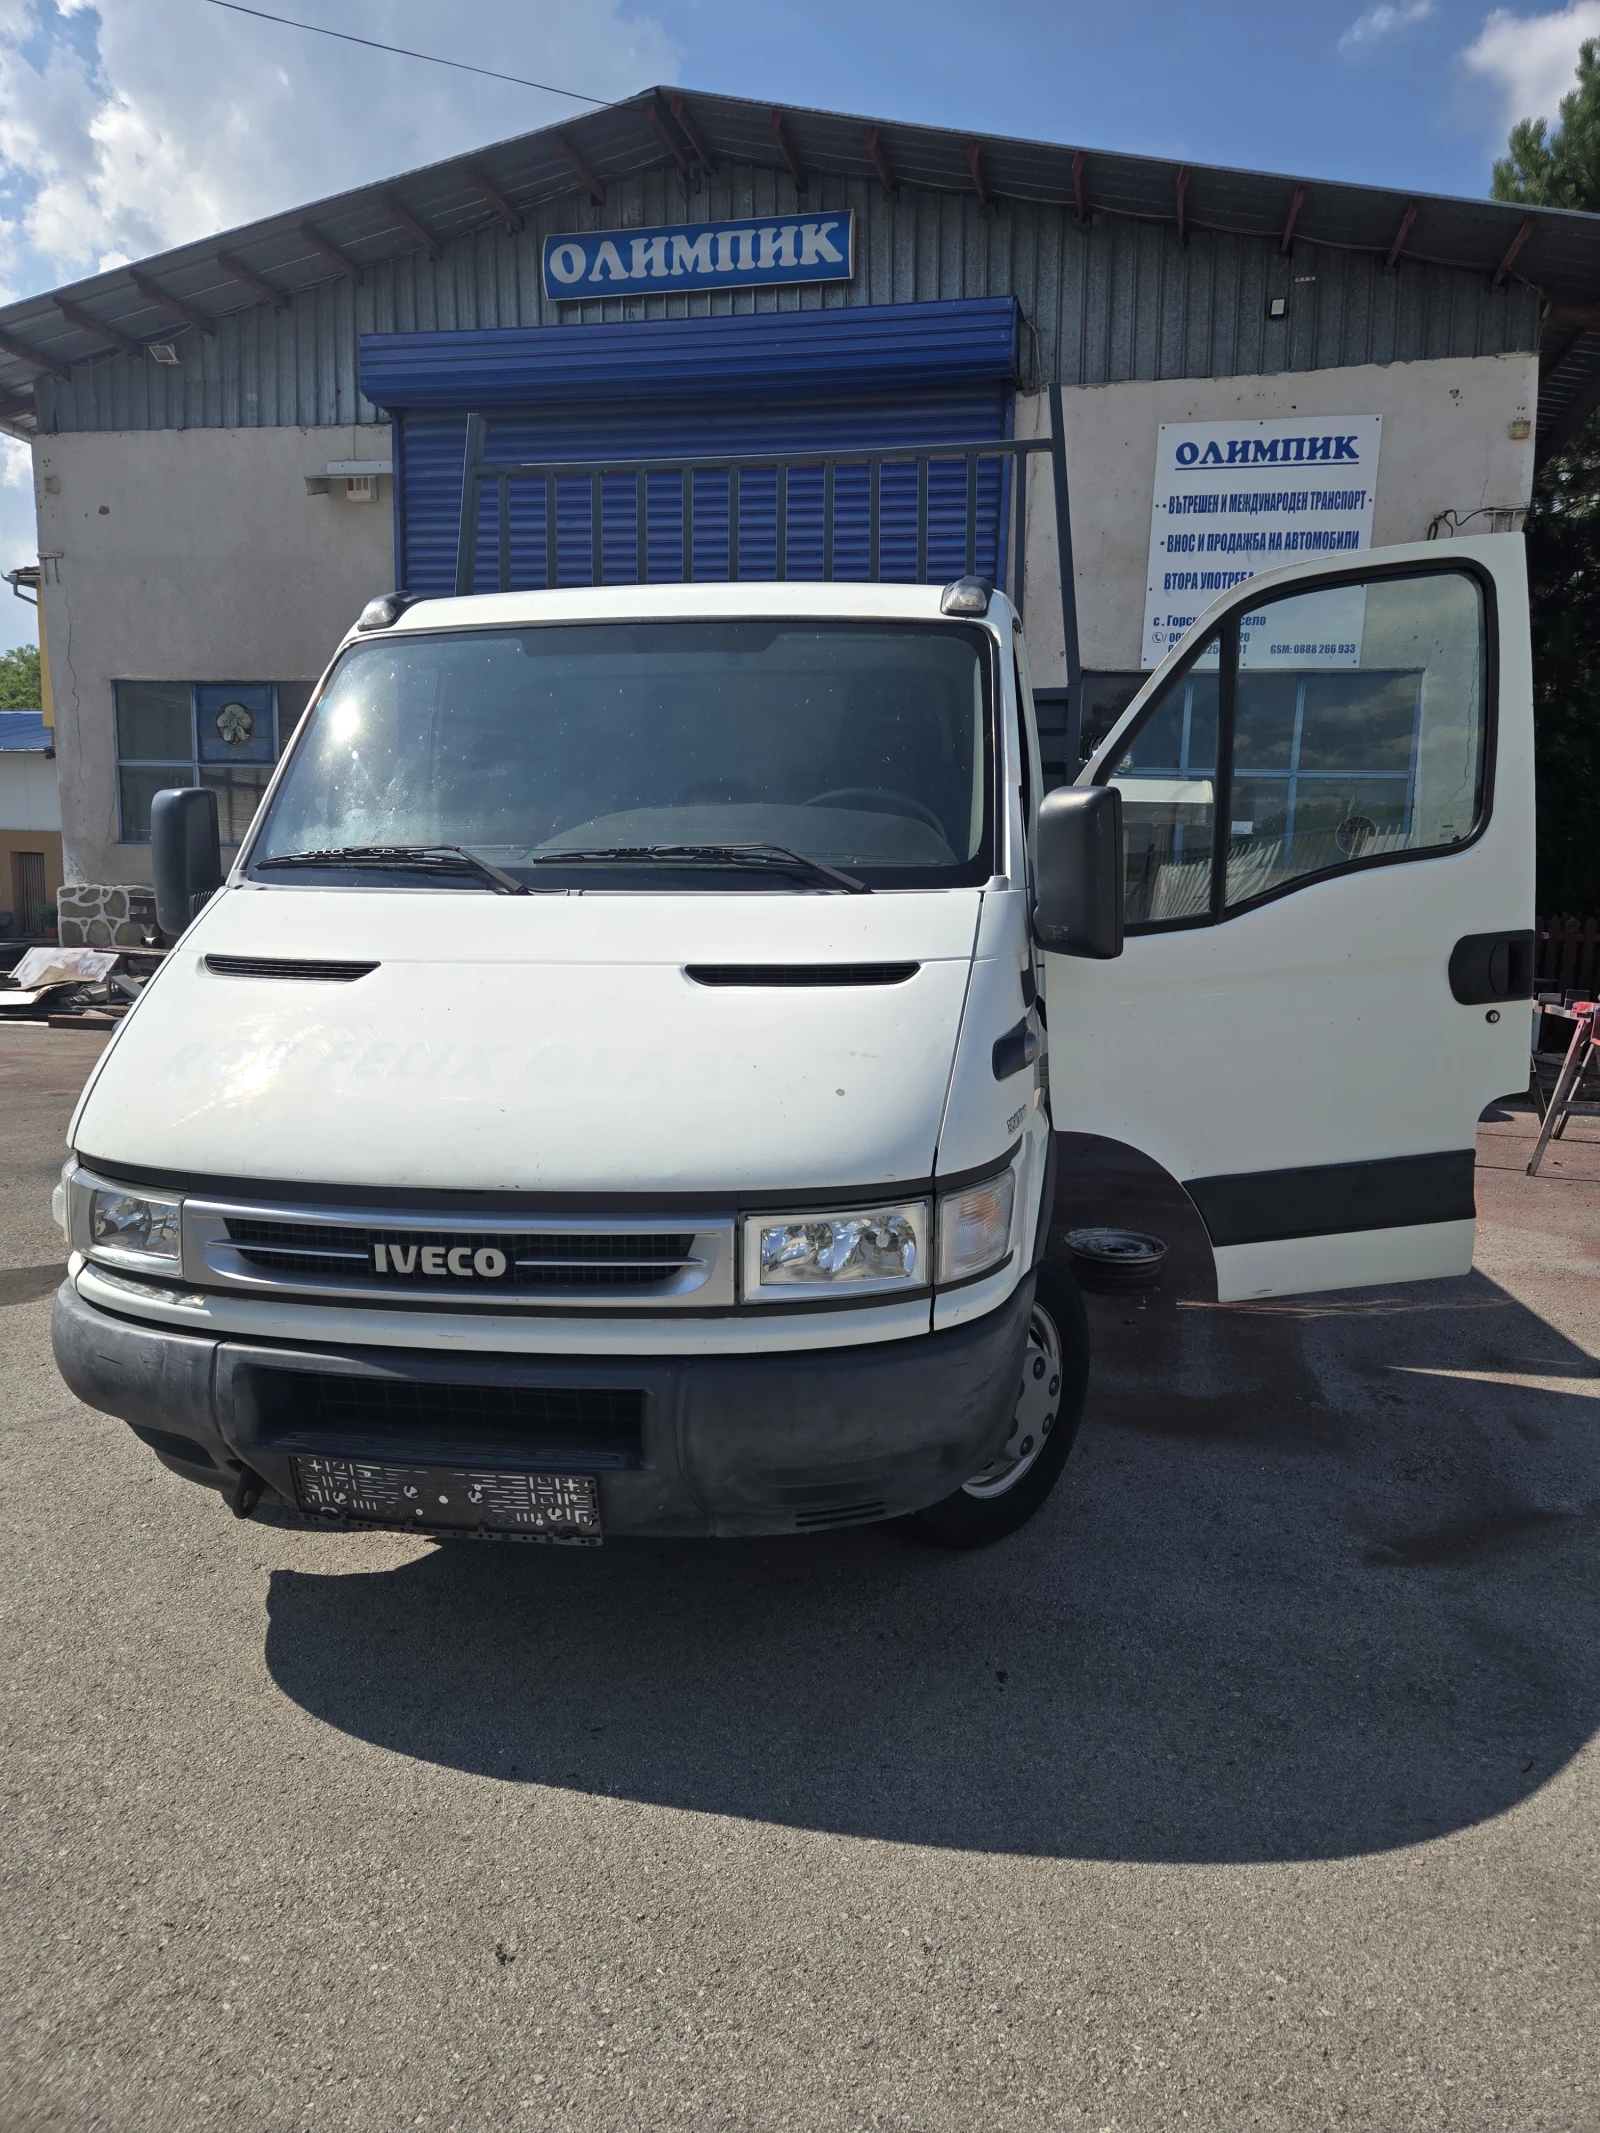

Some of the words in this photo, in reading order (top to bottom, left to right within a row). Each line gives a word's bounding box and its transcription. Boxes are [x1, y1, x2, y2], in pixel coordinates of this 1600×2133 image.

[550, 222, 843, 283] ОЛИМПИК
[1175, 436, 1359, 466] ОЛИМПИК
[1168, 494, 1219, 514] ВЪТРЕШЕН
[1220, 494, 1228, 513] И
[1228, 491, 1308, 515] МЕЖДУНАРОДЕН
[1310, 490, 1367, 511] ТРАНСПОРТ
[1167, 533, 1195, 553] ВНОС
[1198, 533, 1205, 552] И
[1206, 532, 1266, 554] ПРОДАЖБА
[1268, 532, 1282, 551] НА
[1284, 530, 1360, 550] АВТОМОБИЛИ
[1164, 572, 1198, 590] ВТОРА
[1270, 645, 1292, 654] GSM:
[1293, 644, 1317, 654] 0888
[1318, 644, 1337, 654] 266
[1338, 644, 1356, 654] 933
[374, 1243, 507, 1277] IVECO
